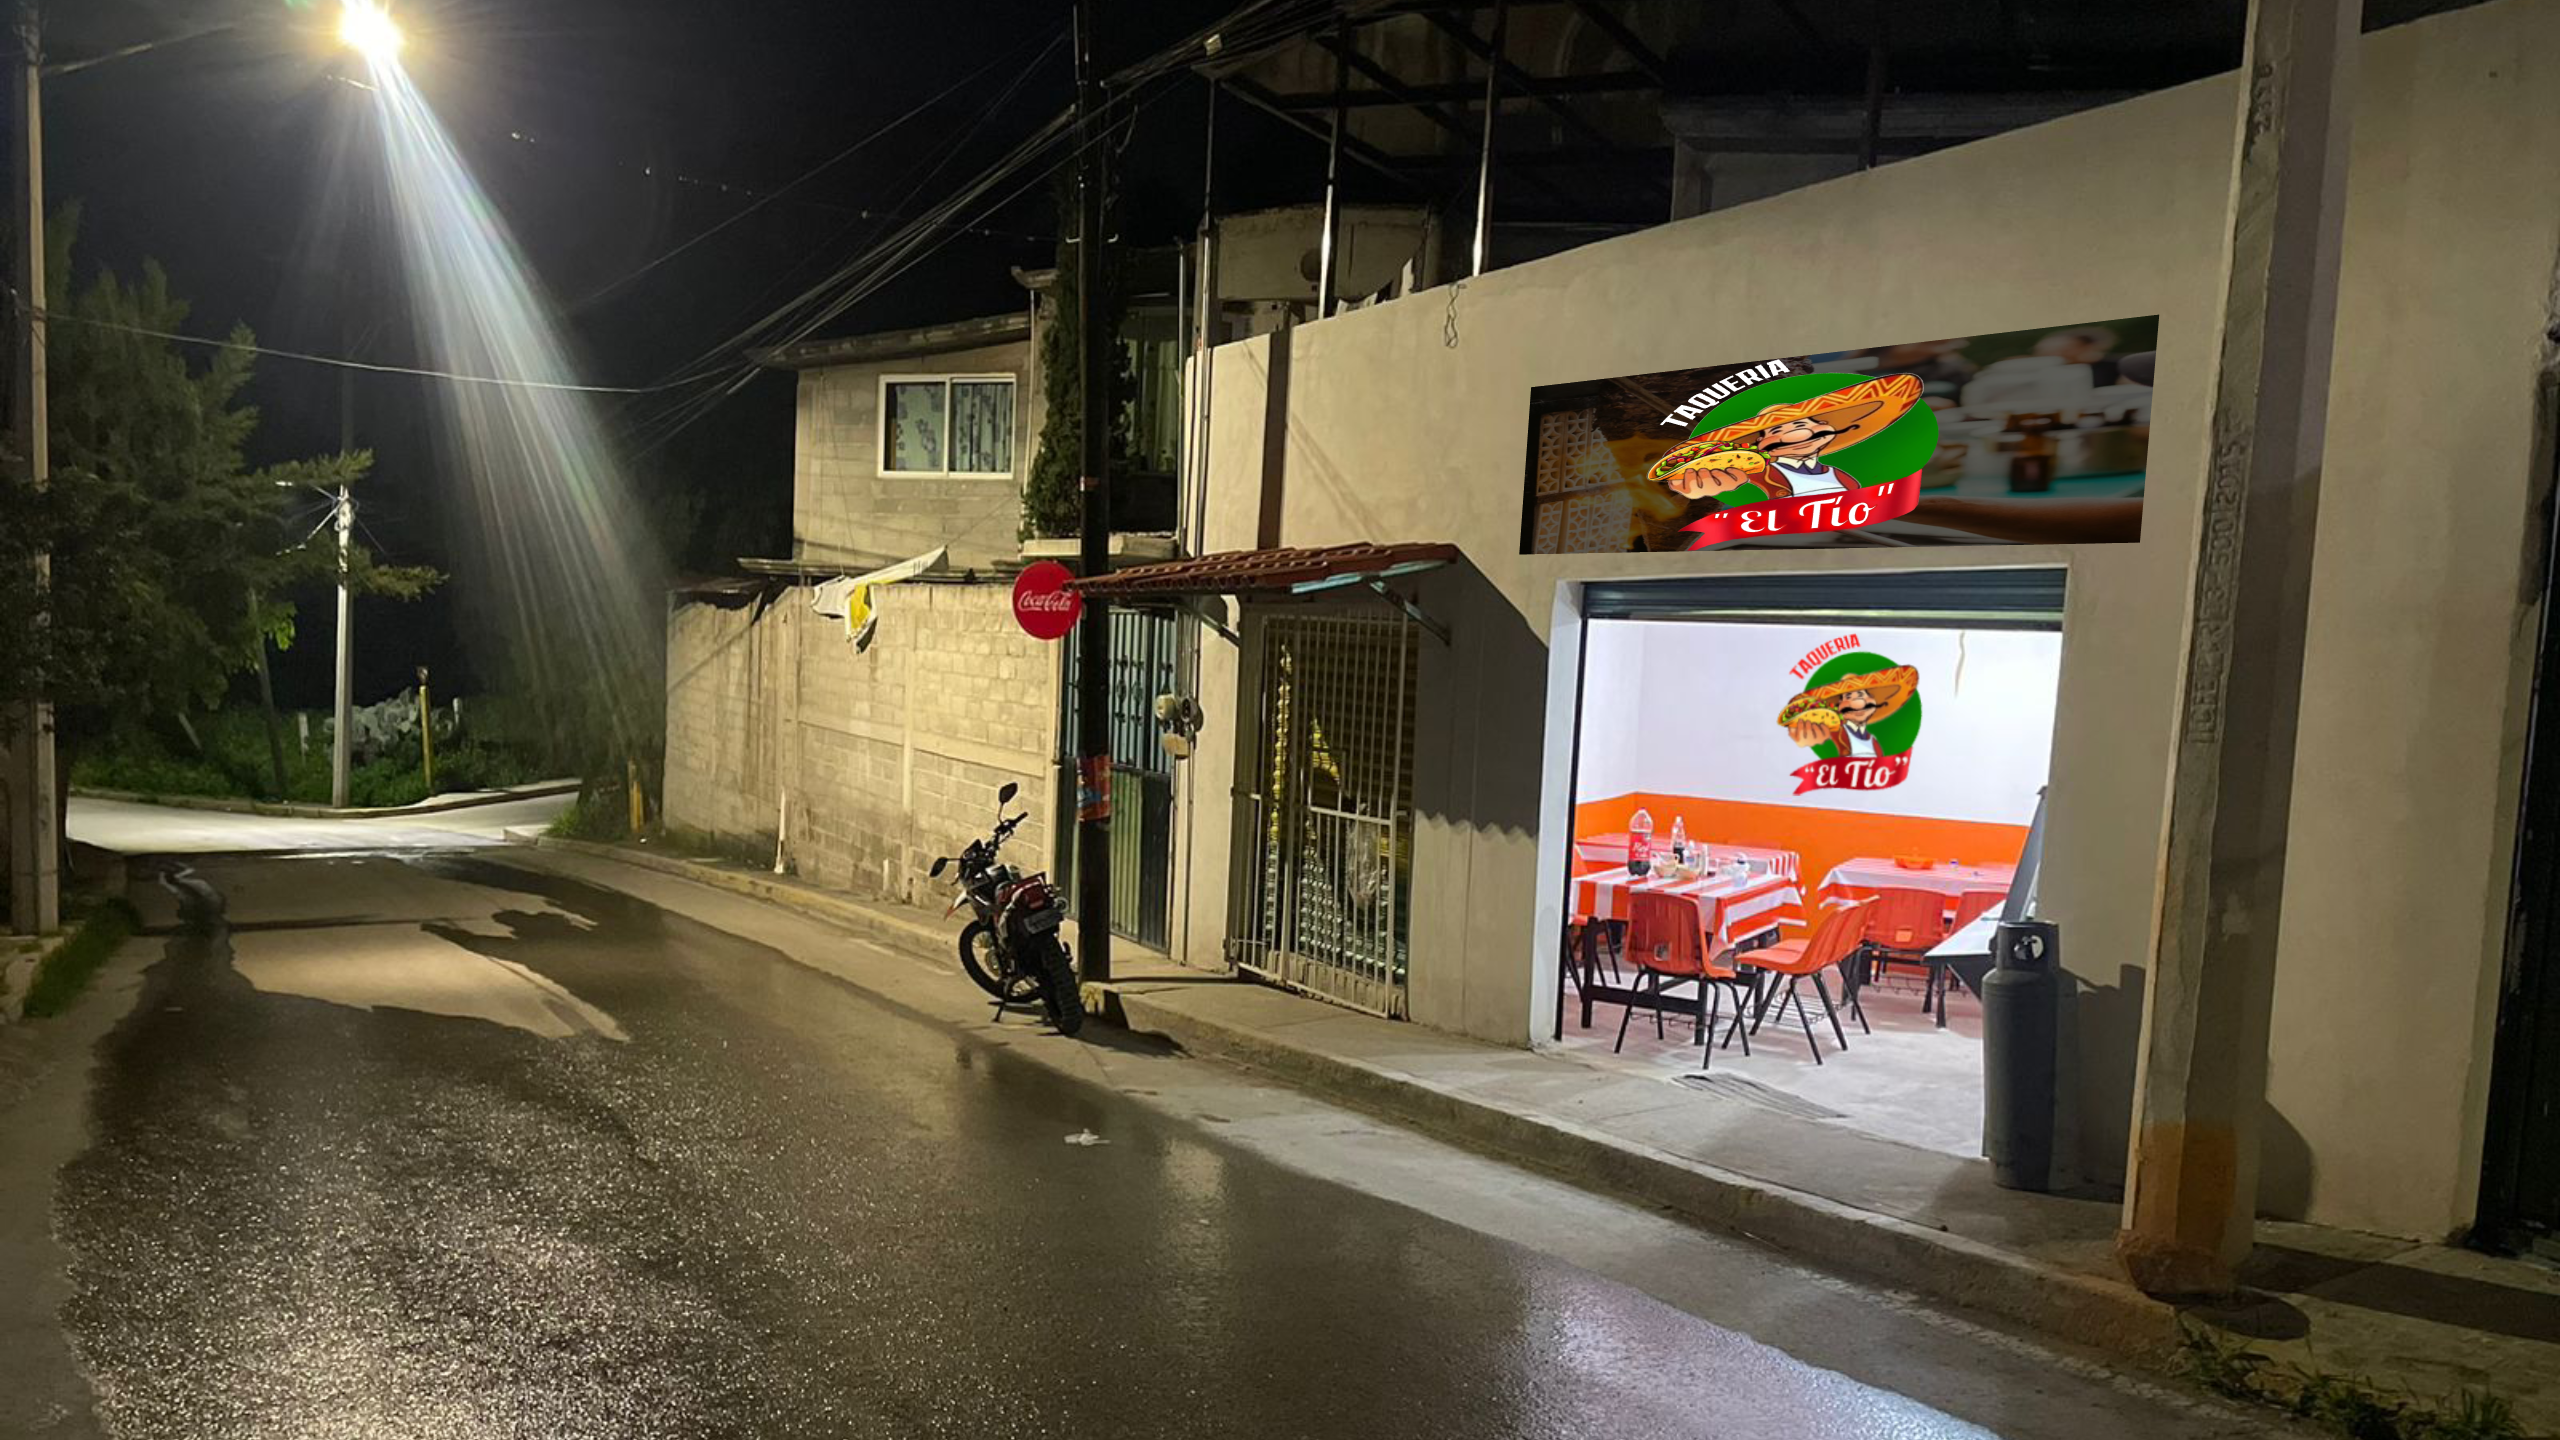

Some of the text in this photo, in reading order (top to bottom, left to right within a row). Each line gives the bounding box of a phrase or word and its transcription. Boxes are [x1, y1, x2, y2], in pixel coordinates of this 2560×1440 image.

[1660, 358, 1790, 428] TAQUERIA
[1018, 590, 1073, 612] Coca-Cola
[1789, 633, 1861, 680] TAQUERIA
